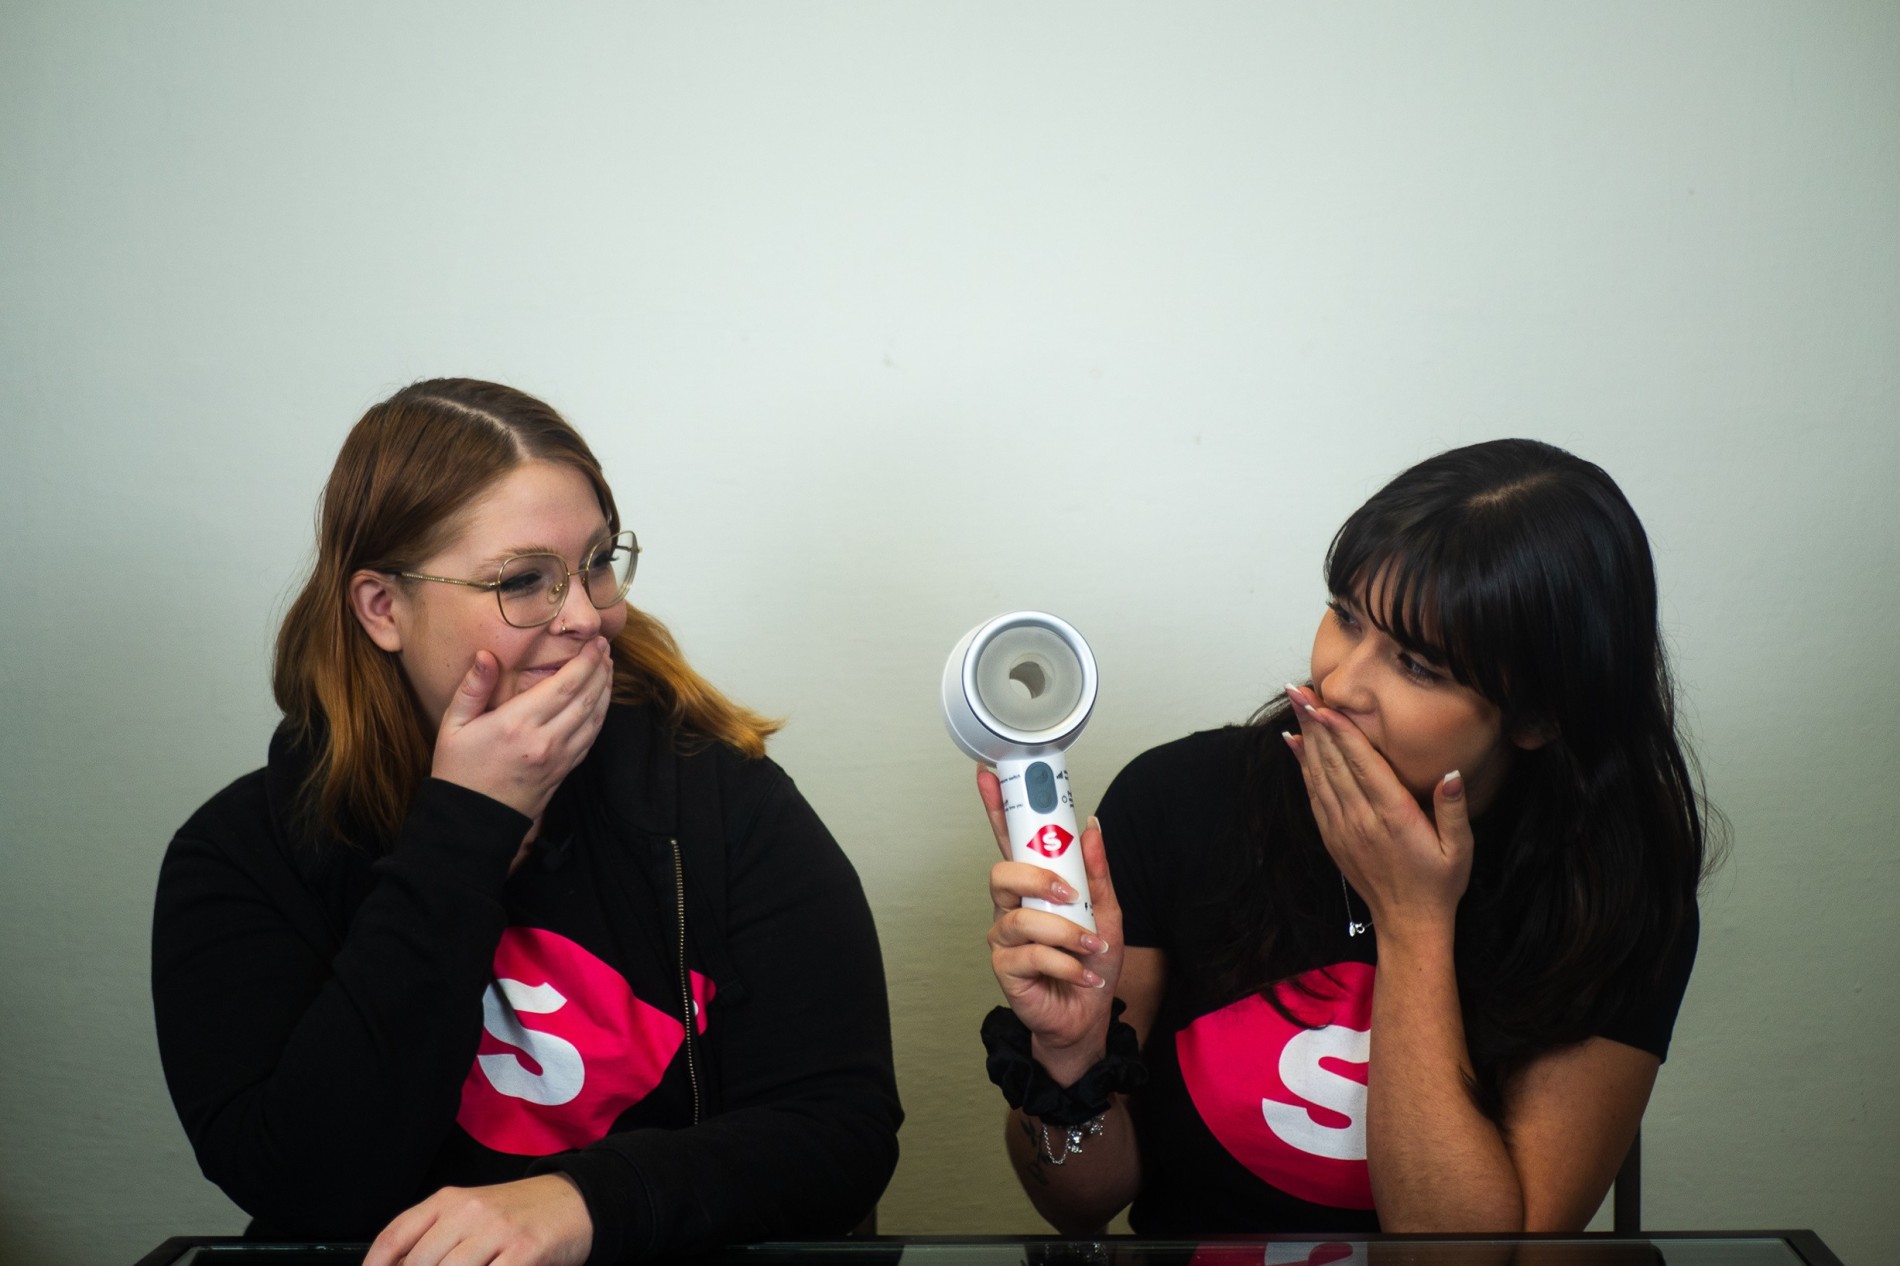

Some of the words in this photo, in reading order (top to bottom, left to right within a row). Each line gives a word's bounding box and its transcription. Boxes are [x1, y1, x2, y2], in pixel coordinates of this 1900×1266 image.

[1042, 832, 1062, 851] S
[477, 978, 585, 1106] S
[1262, 1024, 1370, 1161] S
